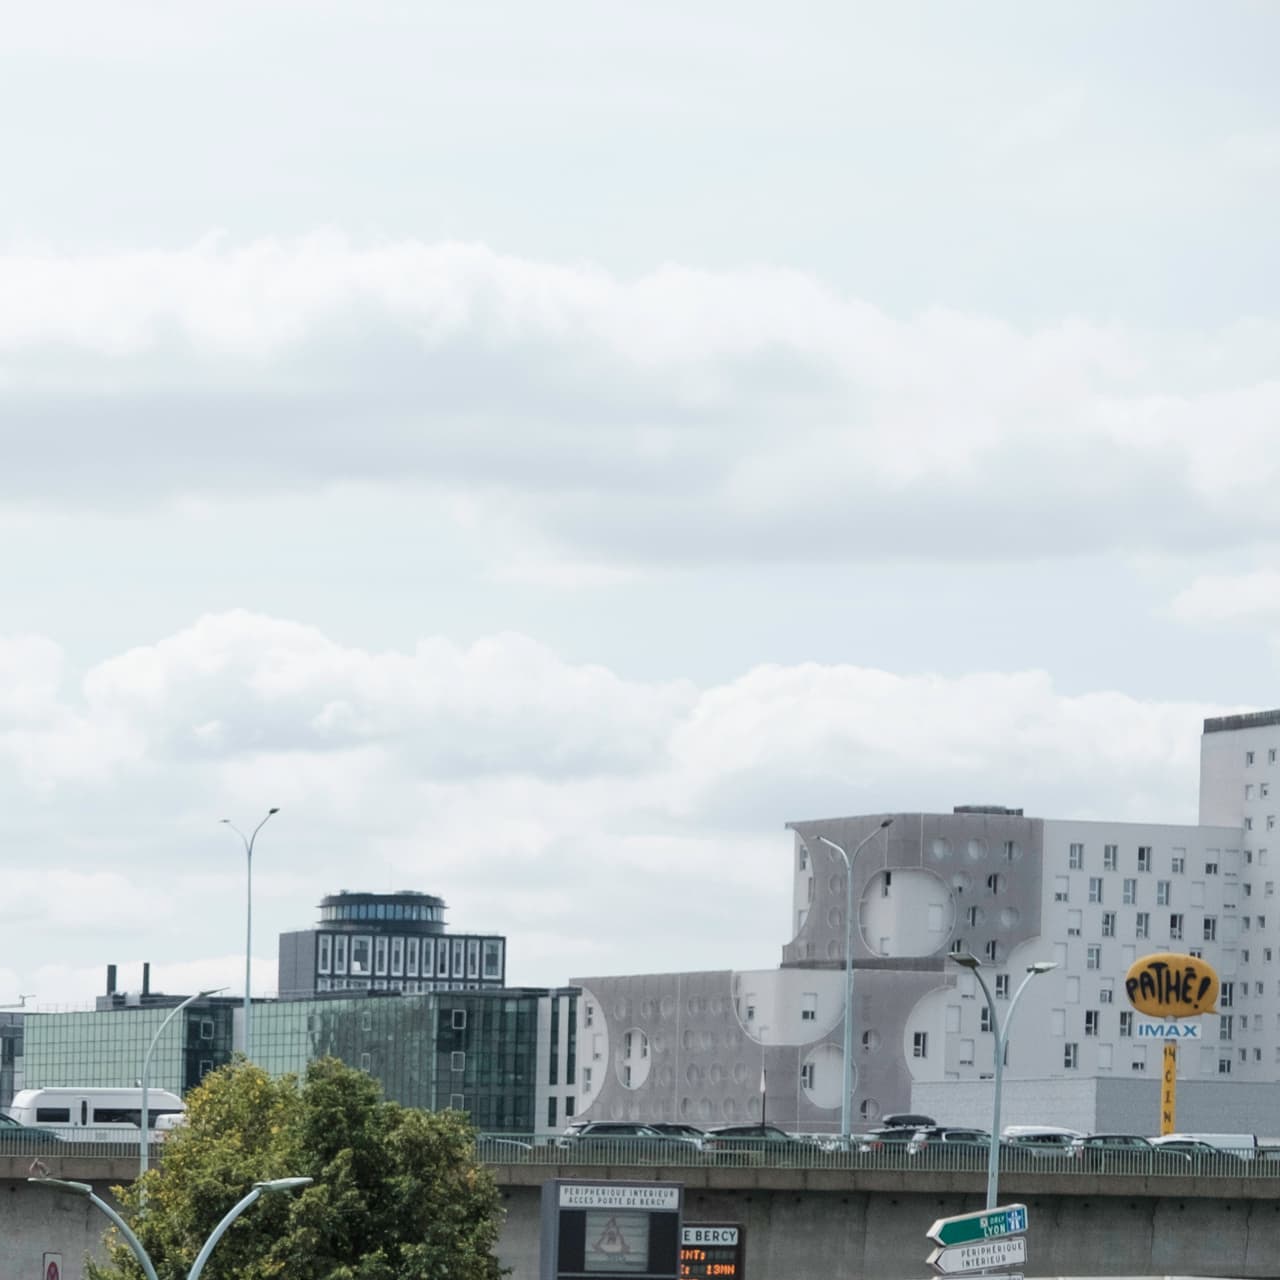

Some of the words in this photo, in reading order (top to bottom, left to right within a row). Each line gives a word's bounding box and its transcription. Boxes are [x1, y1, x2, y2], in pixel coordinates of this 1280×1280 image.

[1138, 1024, 1197, 1036] IMAX
[597, 1197, 622, 1205] PORTE
[639, 1198, 666, 1206] BERCY
[695, 1230, 737, 1241] BERCY
[983, 1224, 1006, 1238] LYON
